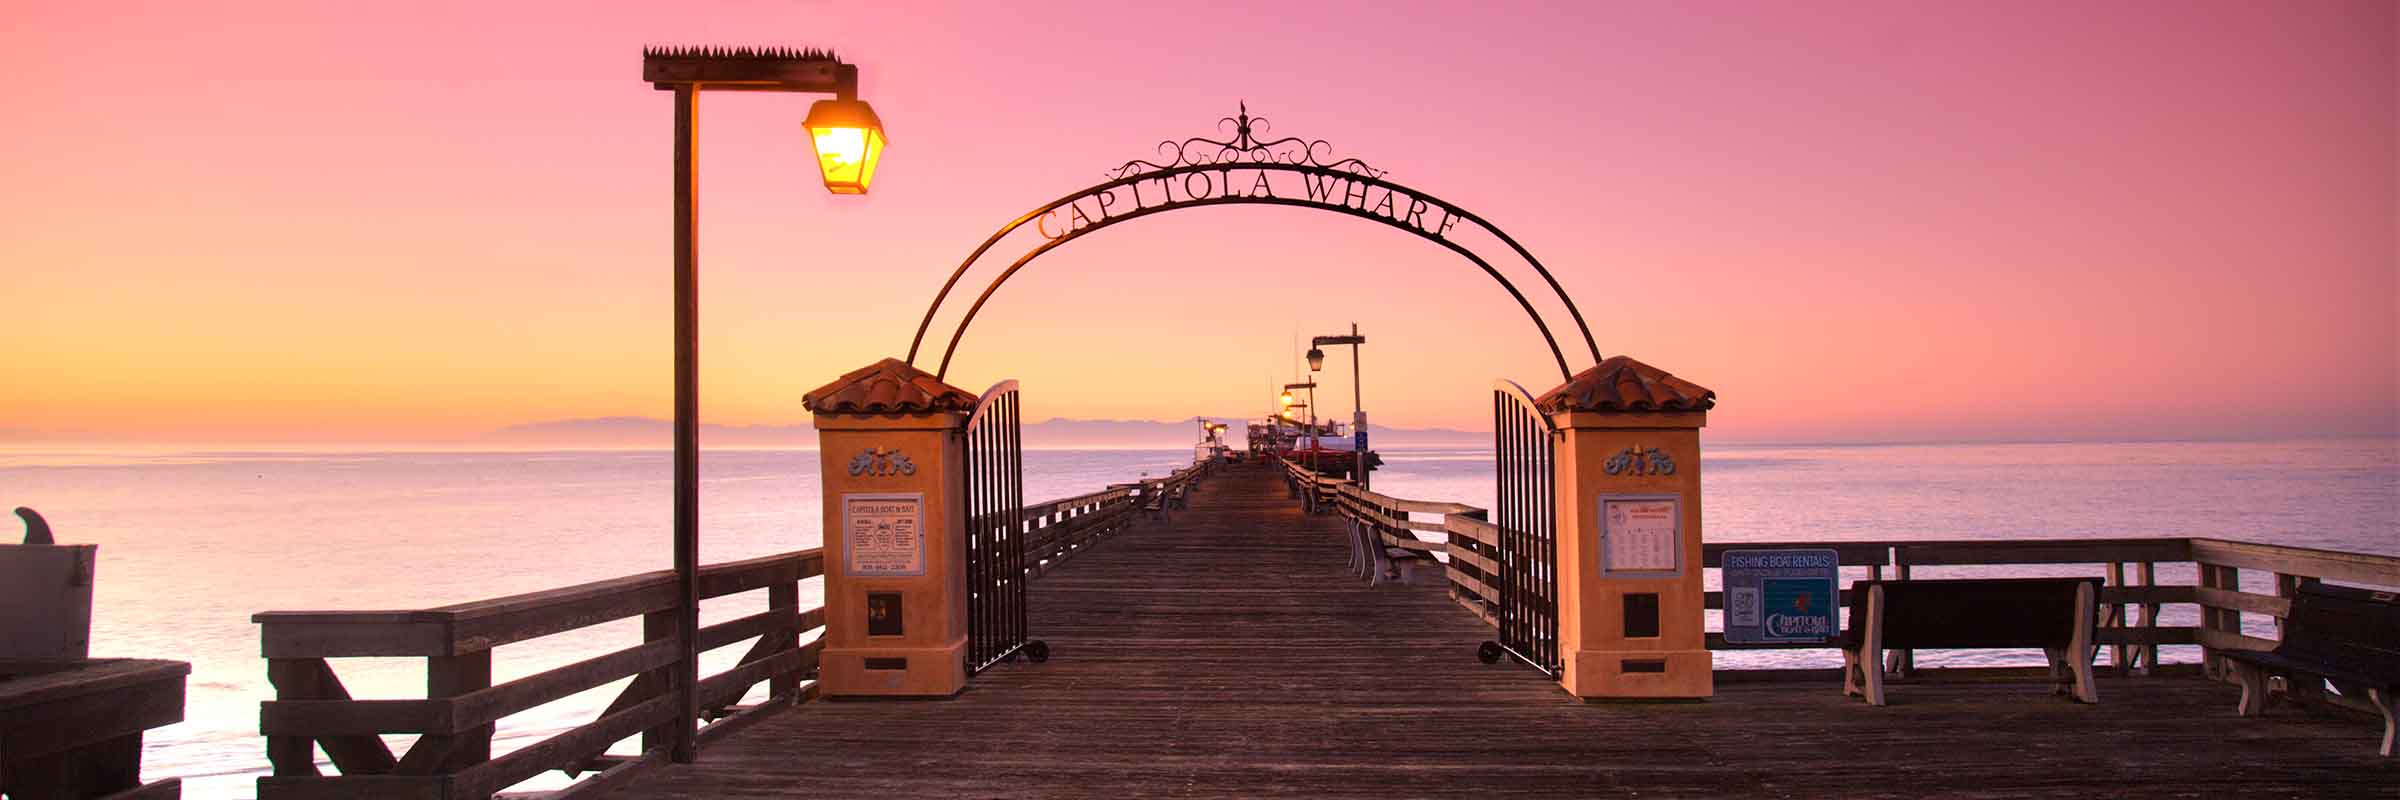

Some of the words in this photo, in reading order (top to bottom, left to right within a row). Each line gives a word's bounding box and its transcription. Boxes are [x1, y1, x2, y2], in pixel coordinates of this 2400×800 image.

[1038, 169, 1275, 241] CAPITOLA
[1304, 172, 1461, 238] WHARF
[1731, 556, 1768, 568] FISHING
[1769, 556, 1791, 568] BOAT
[1792, 556, 1830, 567] RENTALS
